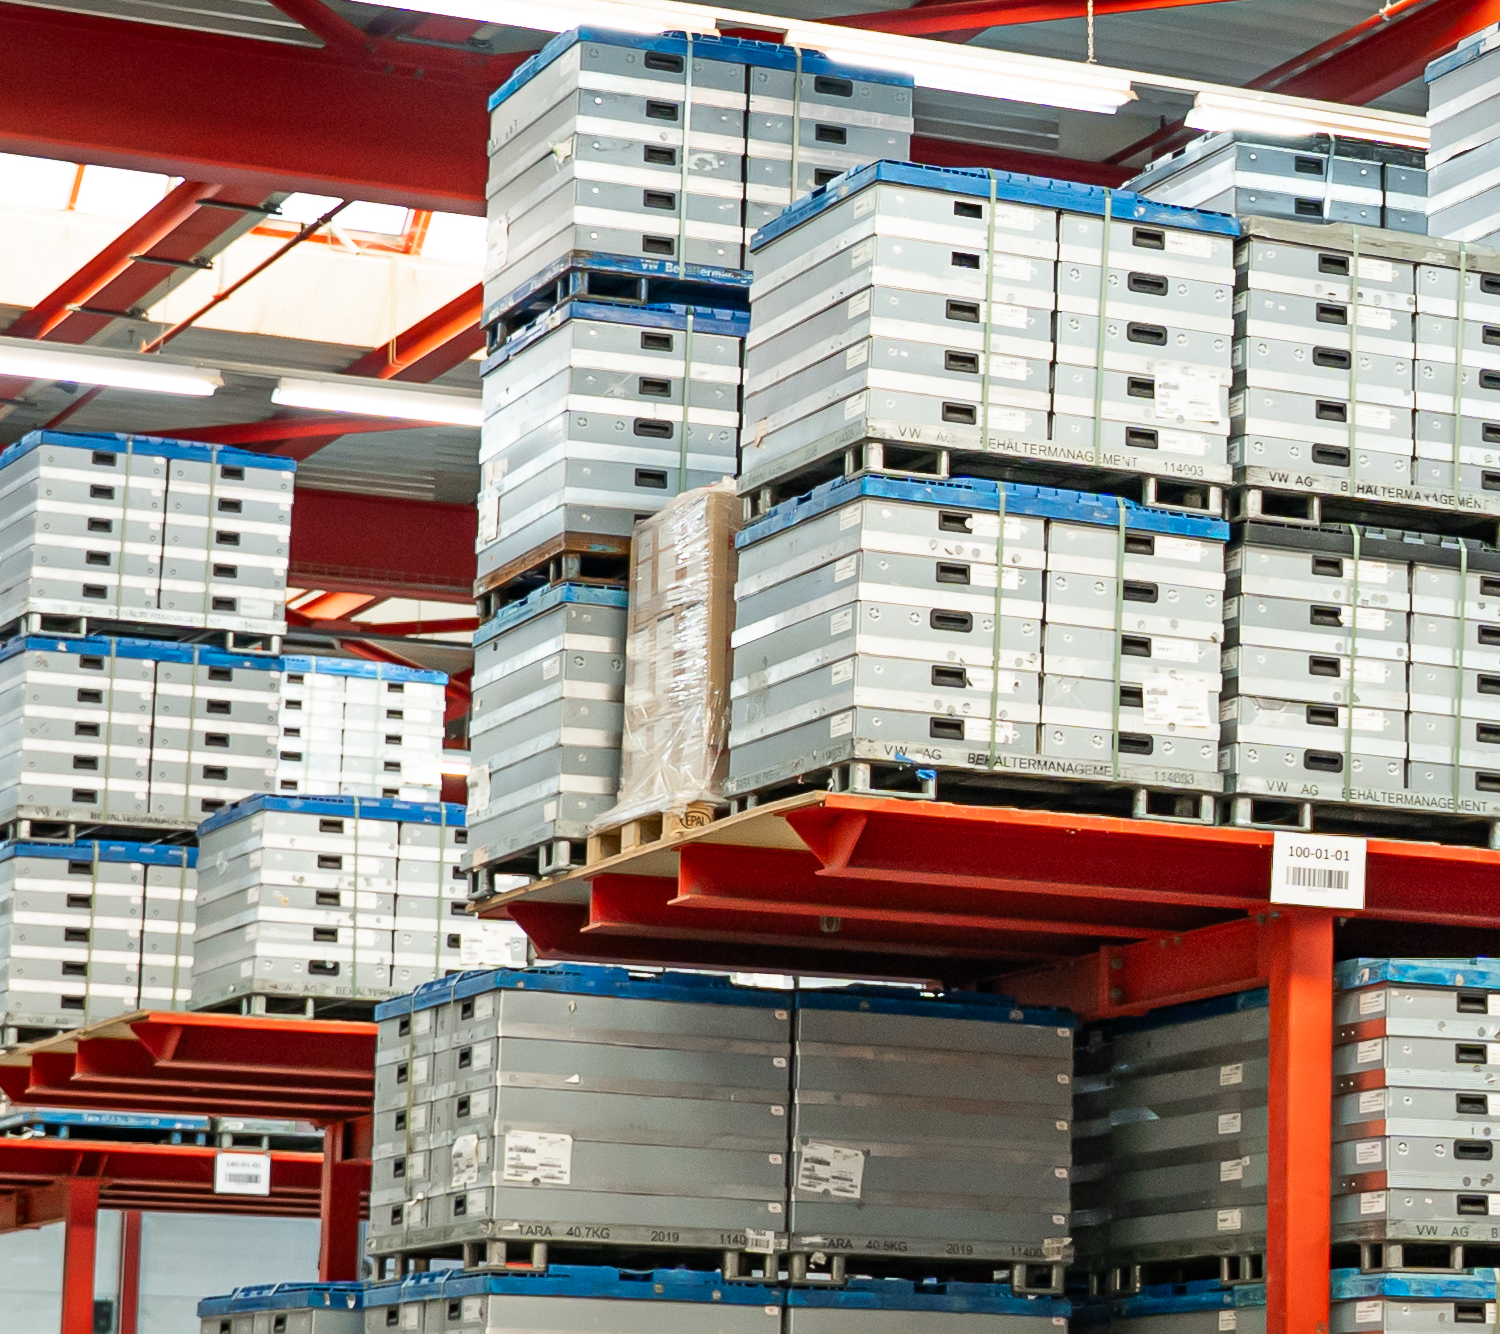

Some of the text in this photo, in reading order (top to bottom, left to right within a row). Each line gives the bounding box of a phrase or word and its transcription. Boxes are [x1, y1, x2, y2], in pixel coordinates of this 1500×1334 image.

[898, 425, 922, 440] VW
[1164, 460, 1204, 478] 114003
[1269, 471, 1314, 487] VW AG
[884, 744, 908, 760] VW
[922, 747, 942, 763] AG
[1266, 780, 1288, 792] VW
[1301, 784, 1319, 796] AG
[1288, 845, 1350, 862] 100-01-01
[519, 1224, 746, 1245] TARA 40.7KG 2019 1140
[1416, 1224, 1438, 1236] VW
[1451, 1226, 1469, 1237] AG
[866, 1239, 908, 1253] 40.5KG
[947, 1243, 974, 1255] 2019
[1011, 1246, 1043, 1258] 11400
